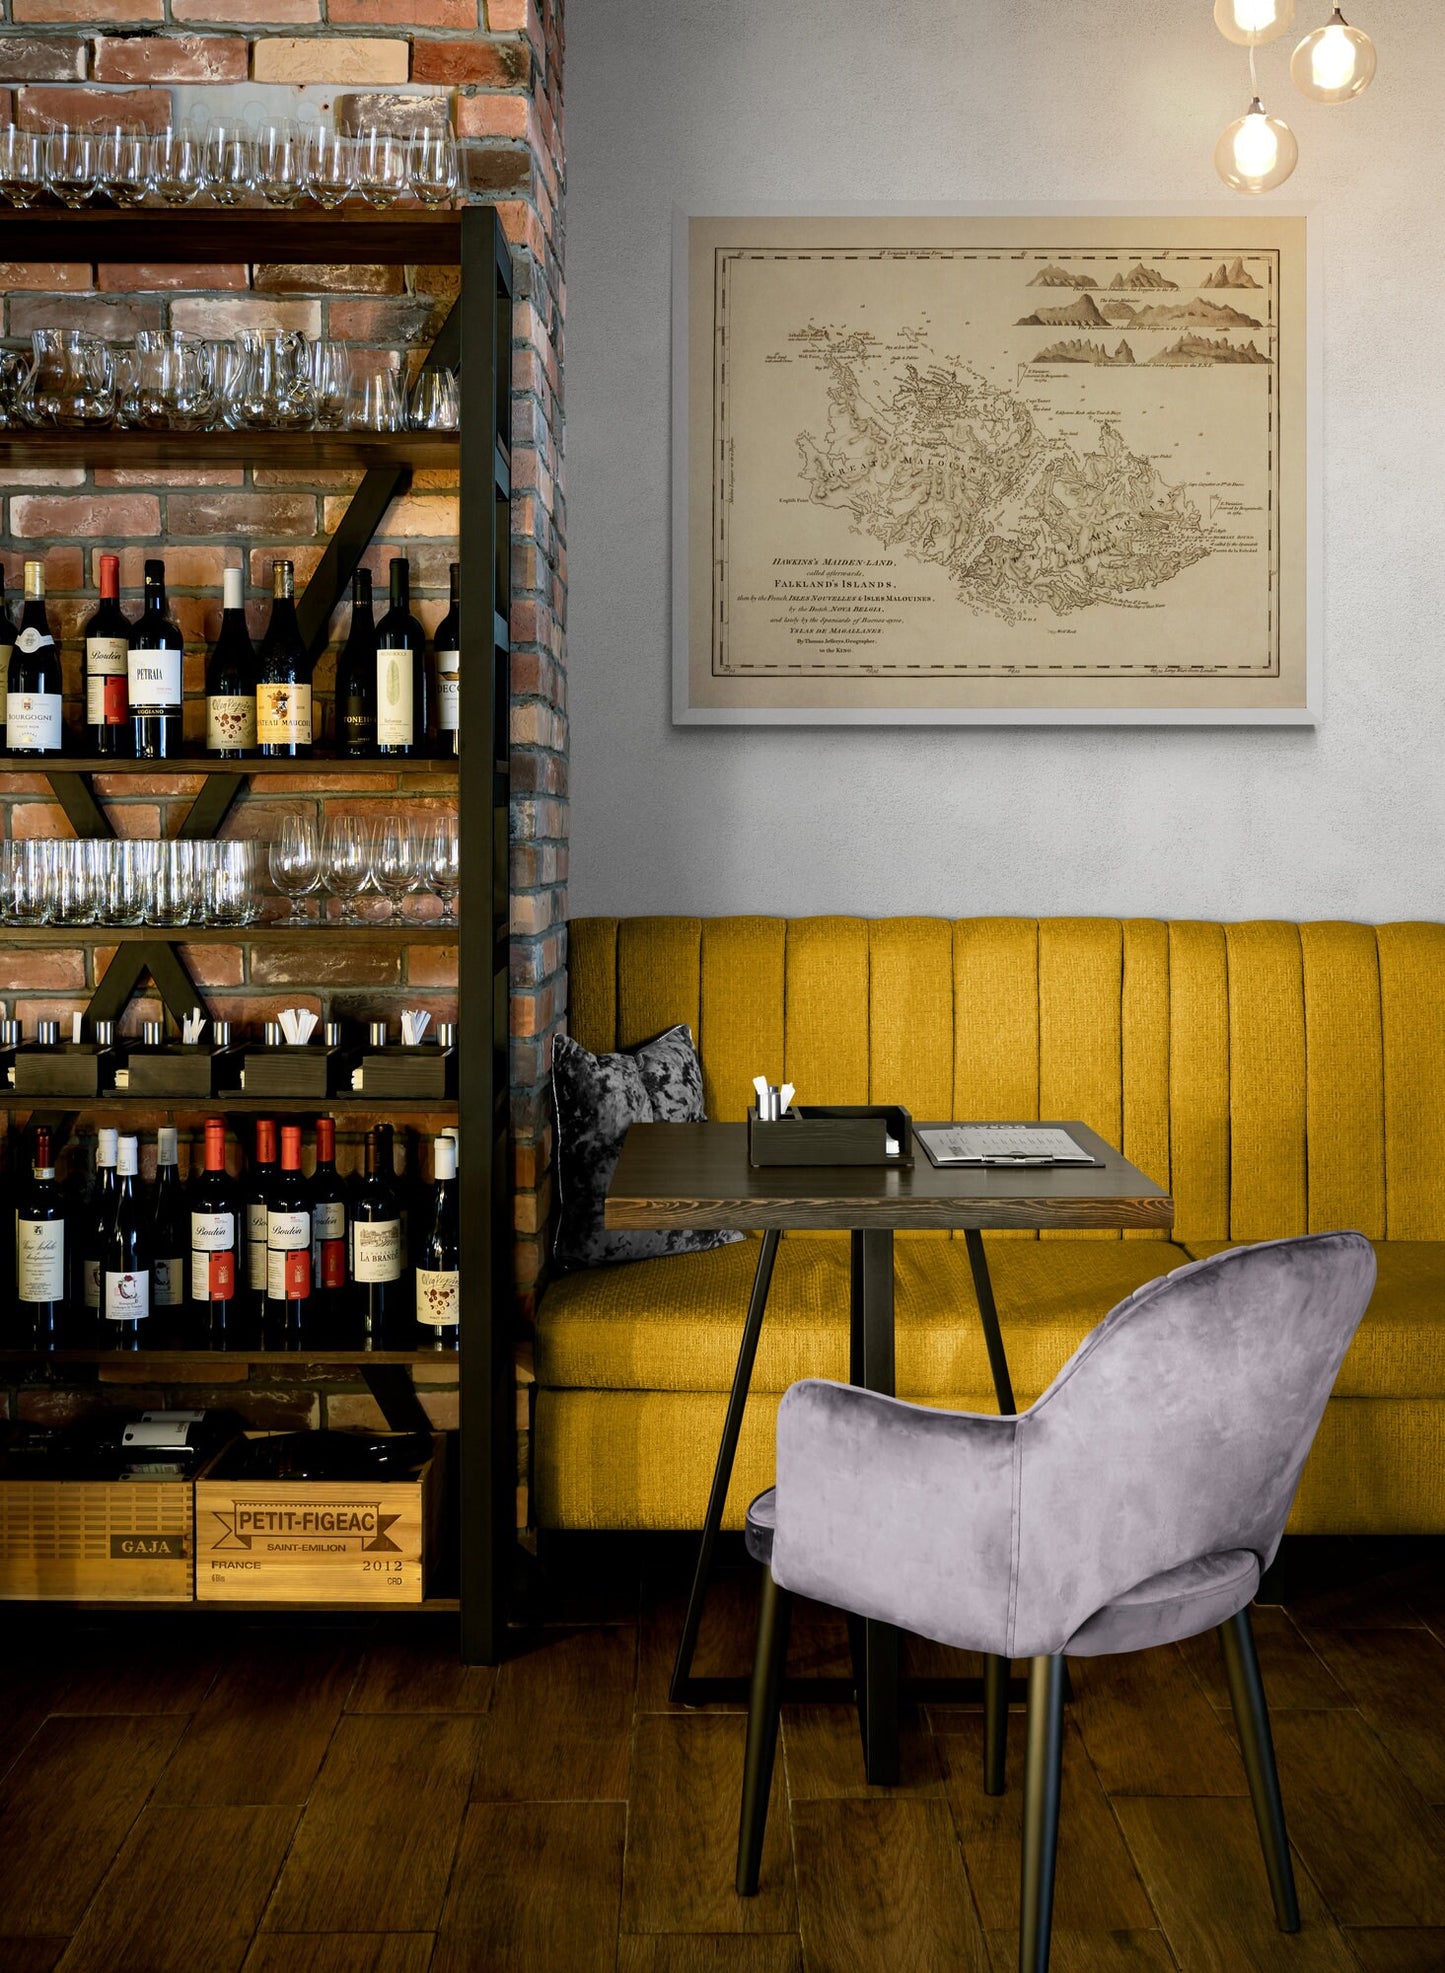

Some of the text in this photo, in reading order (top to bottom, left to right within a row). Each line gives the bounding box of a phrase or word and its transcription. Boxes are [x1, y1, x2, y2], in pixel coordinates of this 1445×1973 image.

[137, 668, 163, 681] PETRAIA
[196, 1227, 227, 1236] Bordón
[272, 1226, 303, 1235] Bordón
[239, 1511, 376, 1533] PETIT-FIGEAC
[121, 1541, 172, 1554] GAJA
[266, 1543, 347, 1552] SAINT-EMILION
[211, 1560, 403, 1573] FRANCE 2012
